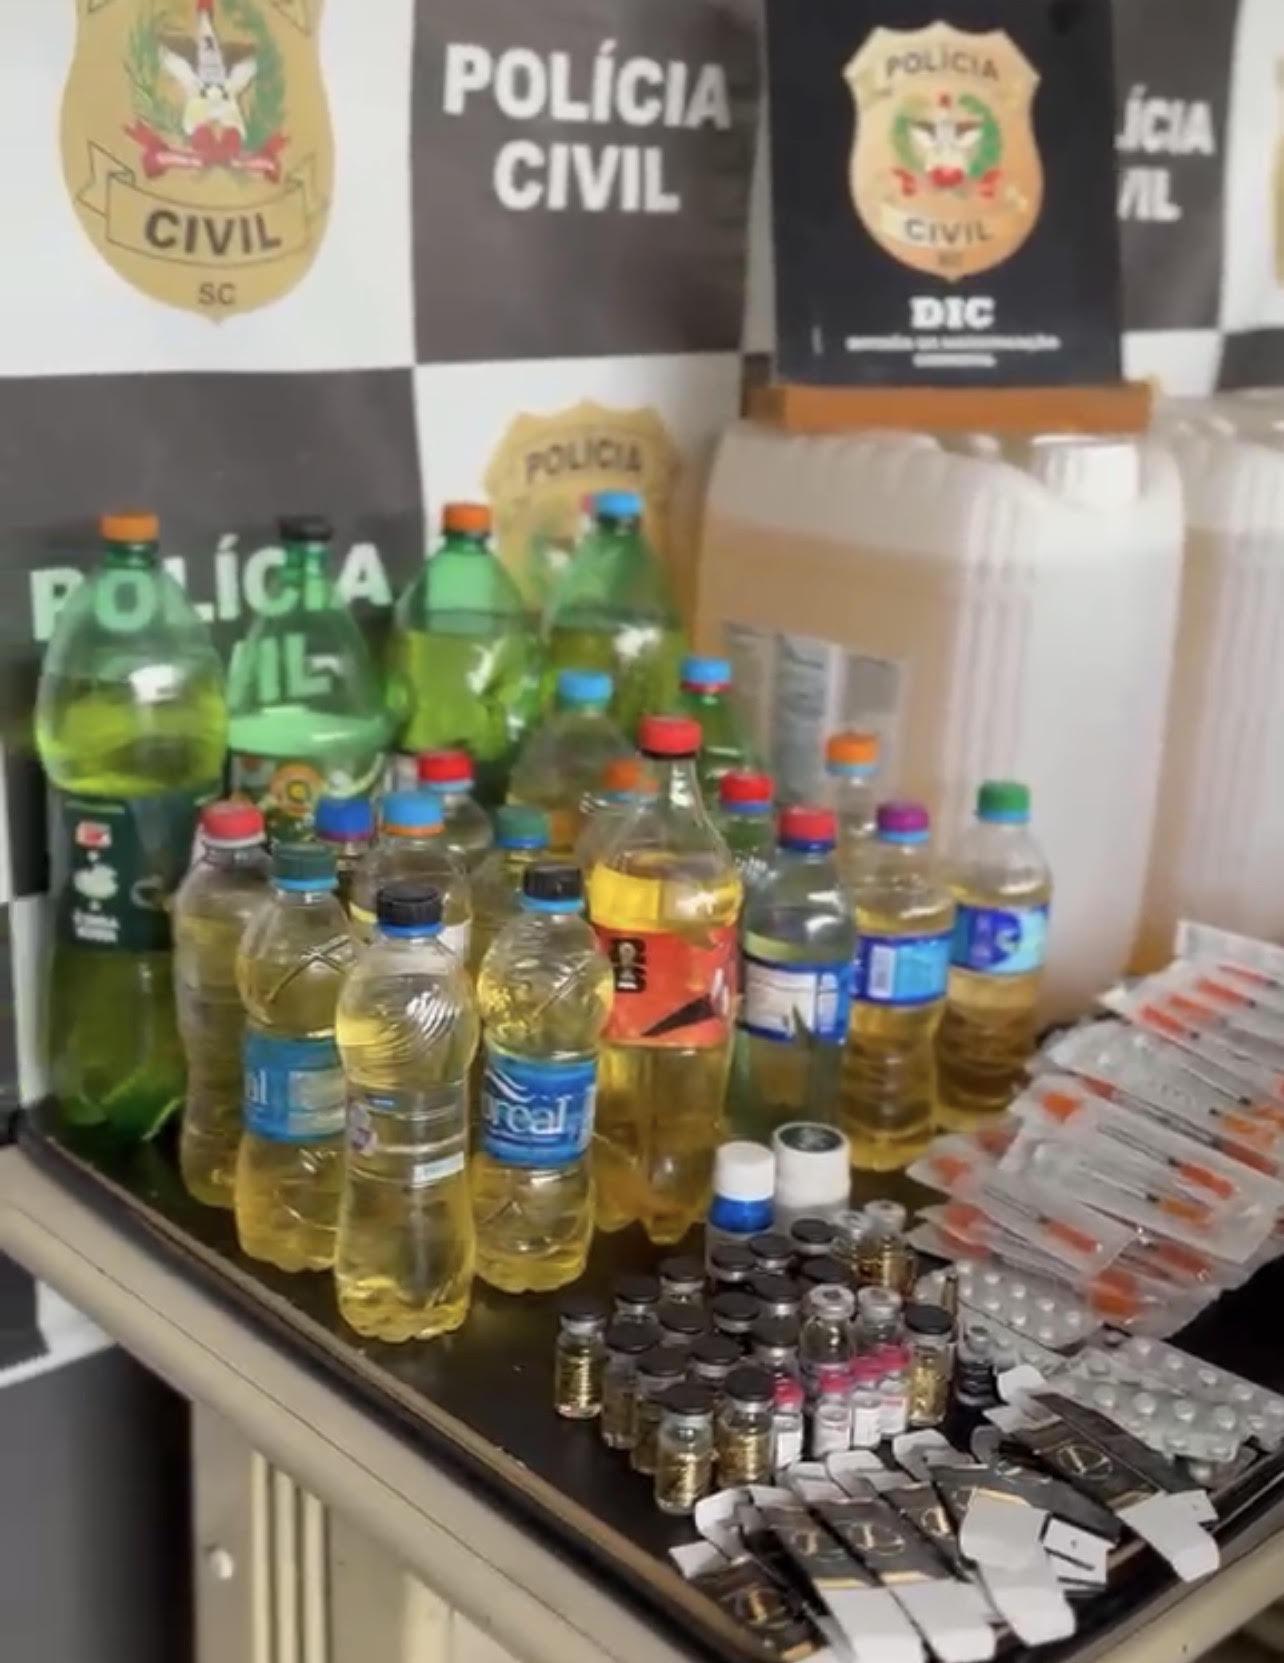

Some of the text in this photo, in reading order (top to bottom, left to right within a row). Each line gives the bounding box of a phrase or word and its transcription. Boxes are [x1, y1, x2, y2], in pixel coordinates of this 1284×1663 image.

[443, 38, 732, 130] POLÍCIA
[885, 43, 1000, 82] POLÍCIA
[494, 139, 682, 214] CIVIL
[143, 208, 282, 257] CIVIL
[904, 217, 993, 244] CIVIL
[198, 282, 236, 307] SC
[909, 296, 996, 331] DIC
[30, 533, 394, 642] POLÍCIA
